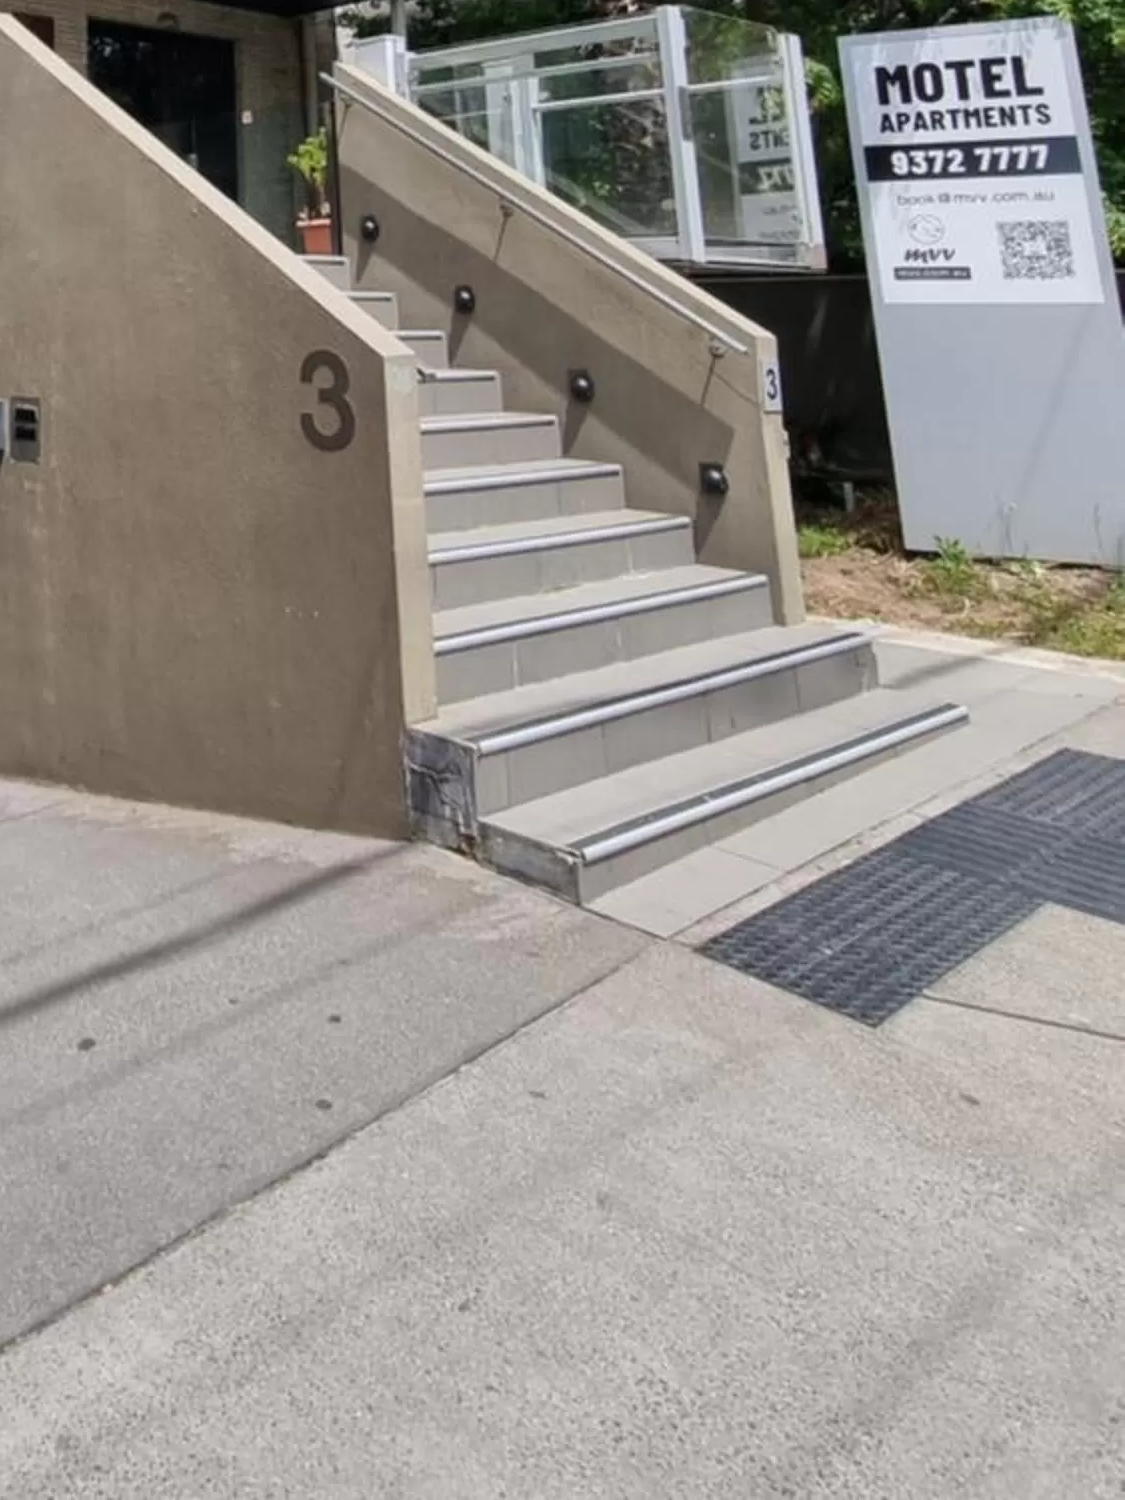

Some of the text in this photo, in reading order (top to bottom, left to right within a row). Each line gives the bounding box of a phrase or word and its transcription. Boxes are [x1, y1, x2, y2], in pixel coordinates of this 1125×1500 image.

[874, 55, 1045, 106] MOTEL
[879, 103, 1052, 134] APARTMENTS
[890, 144, 1050, 176] 9372 7777
[299, 349, 357, 453] 3
[766, 367, 778, 401] 3
